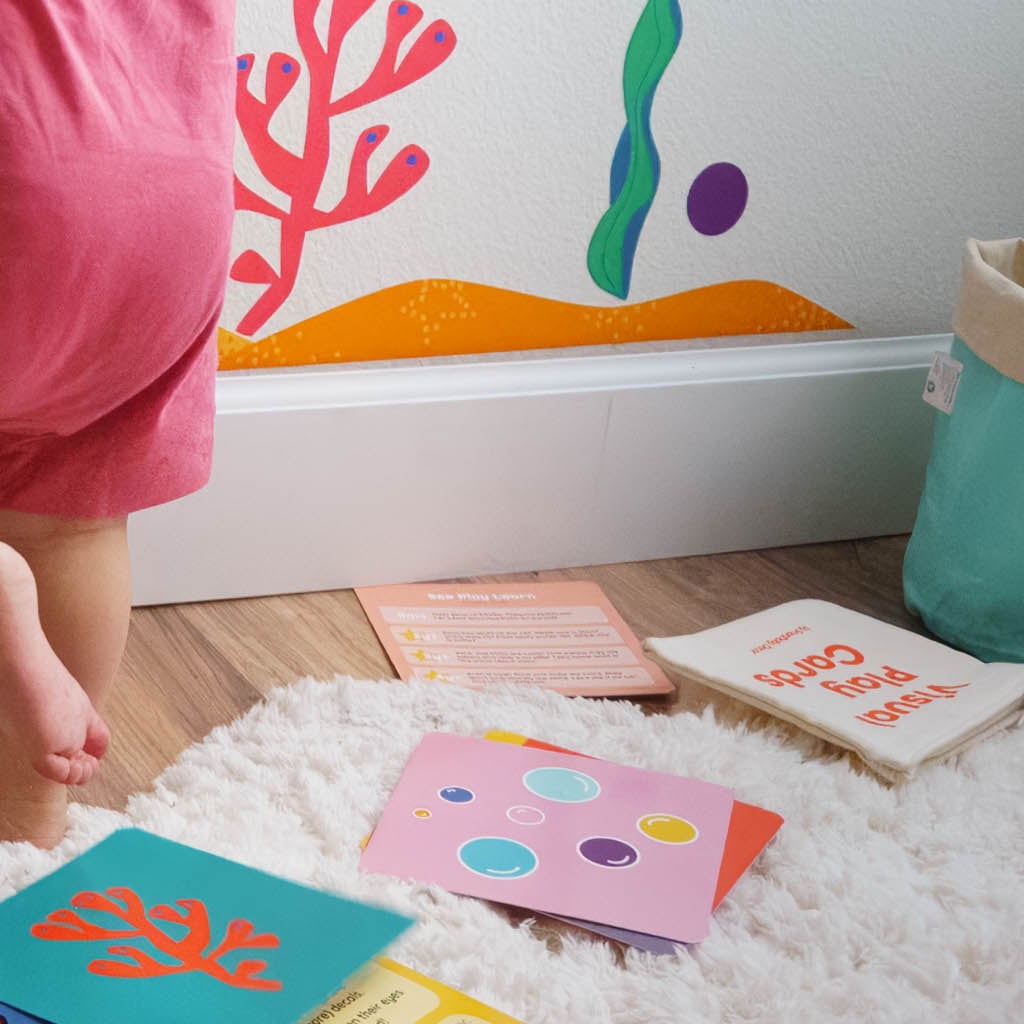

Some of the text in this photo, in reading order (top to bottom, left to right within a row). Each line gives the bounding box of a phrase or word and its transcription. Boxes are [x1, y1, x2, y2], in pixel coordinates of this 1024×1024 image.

[753, 644, 864, 688] Cards
[820, 666, 919, 698] Play
[855, 682, 971, 727] Visual
[380, 990, 404, 1005] eyes
